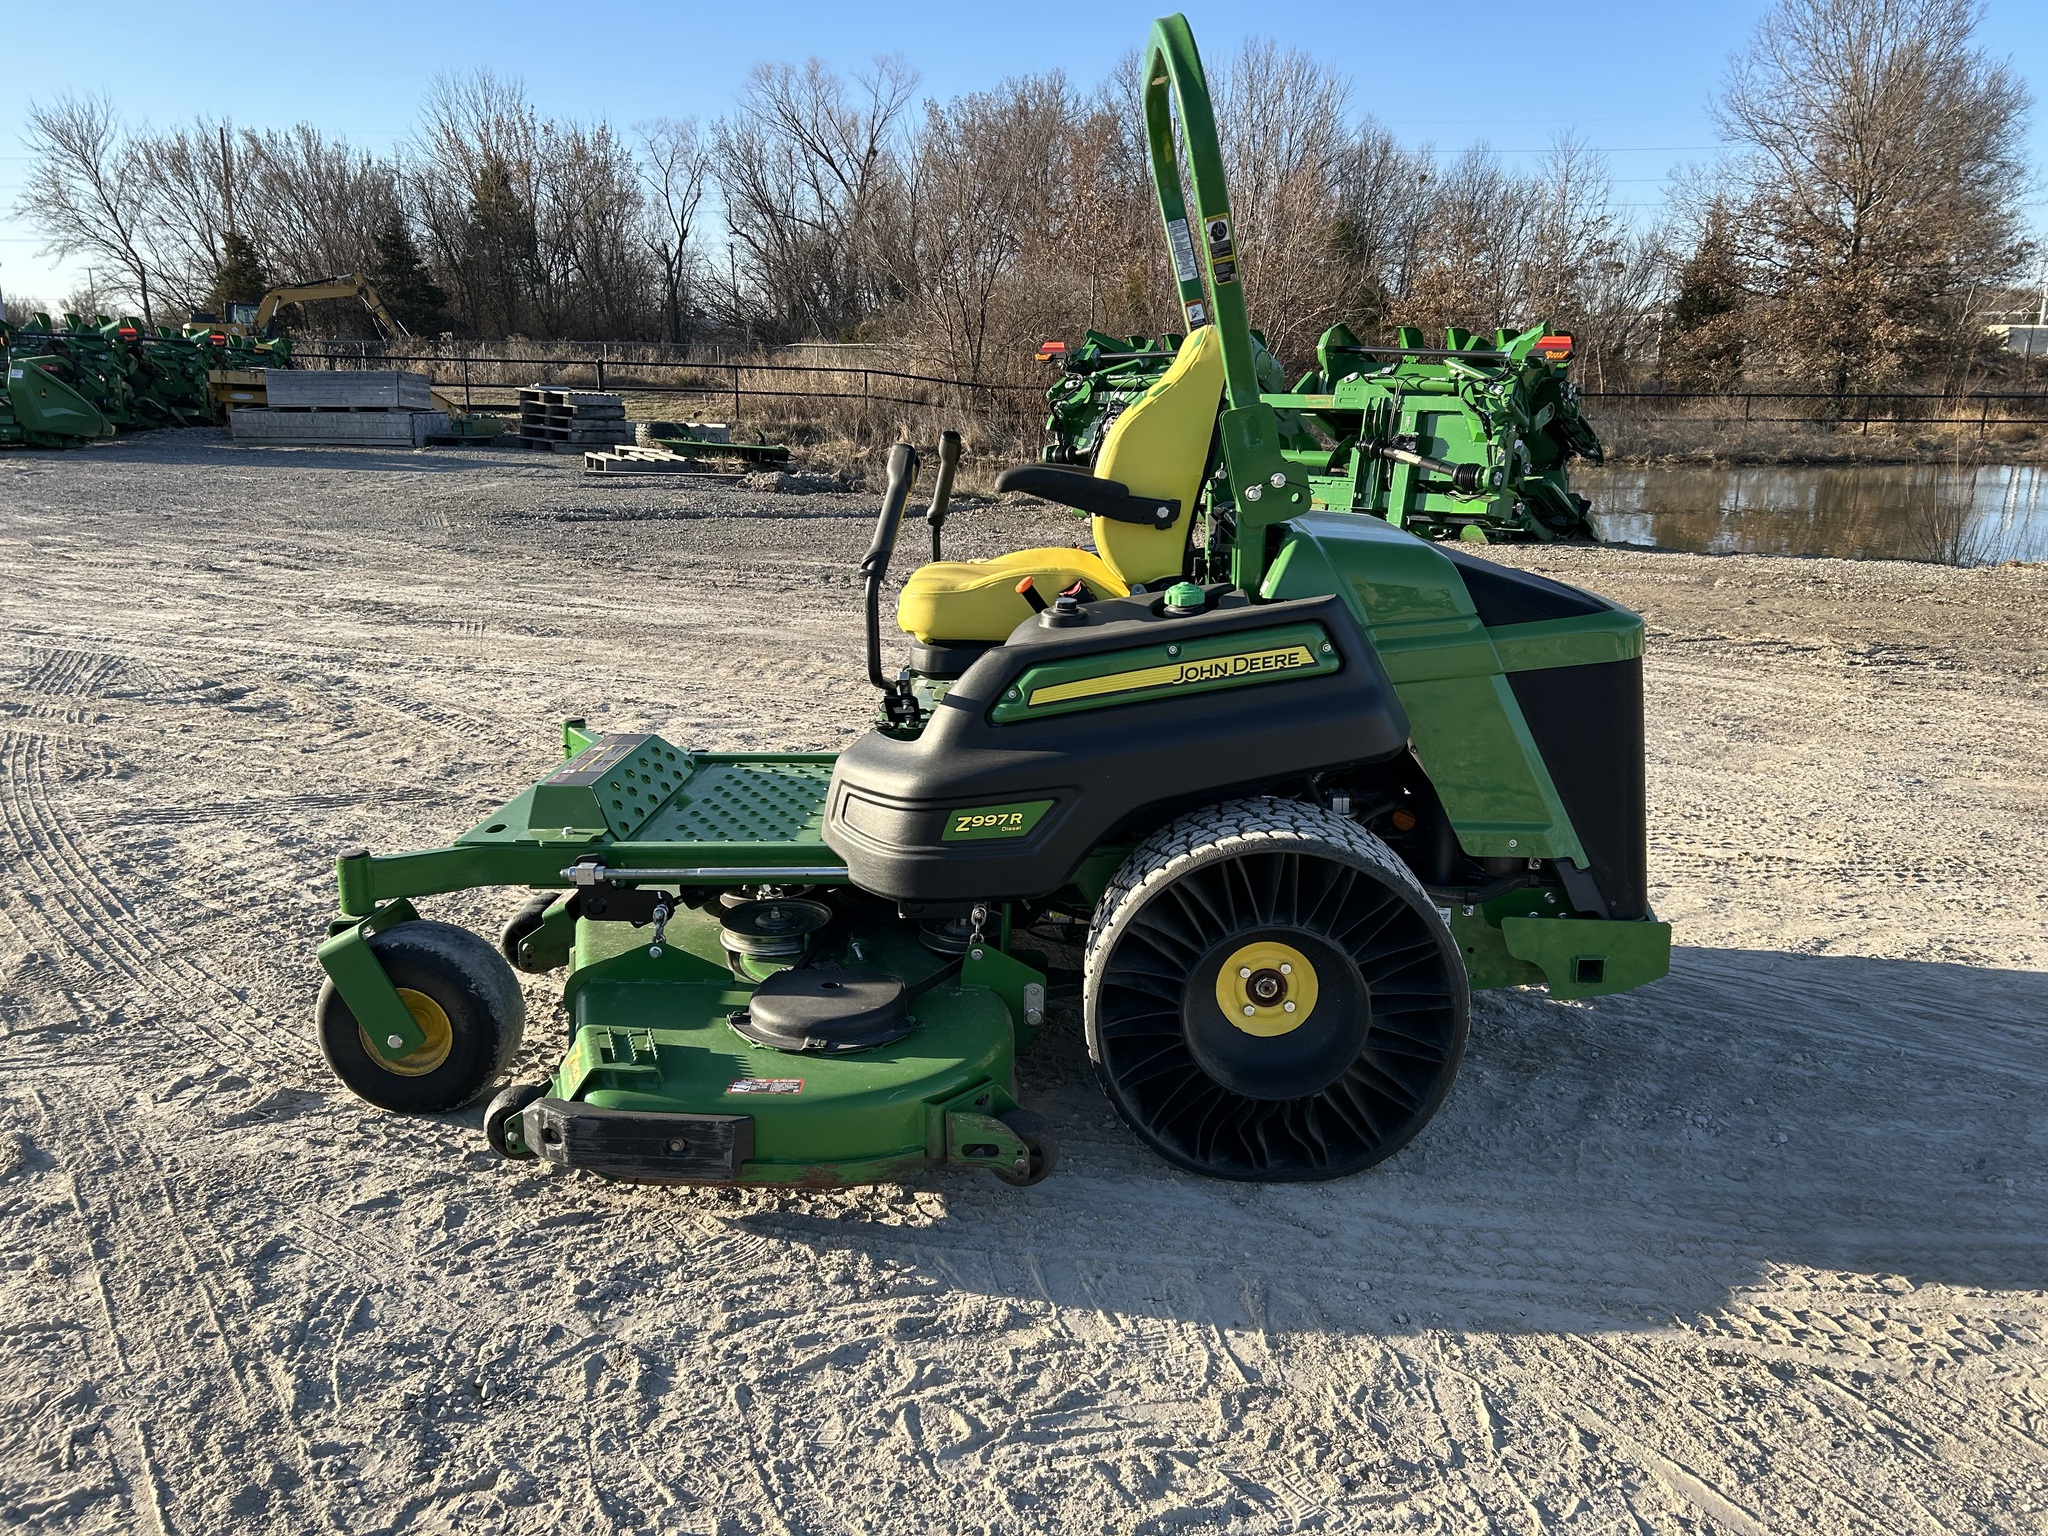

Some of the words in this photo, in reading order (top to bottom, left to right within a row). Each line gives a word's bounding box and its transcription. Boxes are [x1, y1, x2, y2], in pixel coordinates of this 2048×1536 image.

[1173, 662, 1228, 683] JOHN
[1233, 652, 1300, 674] DEERE
[955, 813, 1023, 832] Z997R
